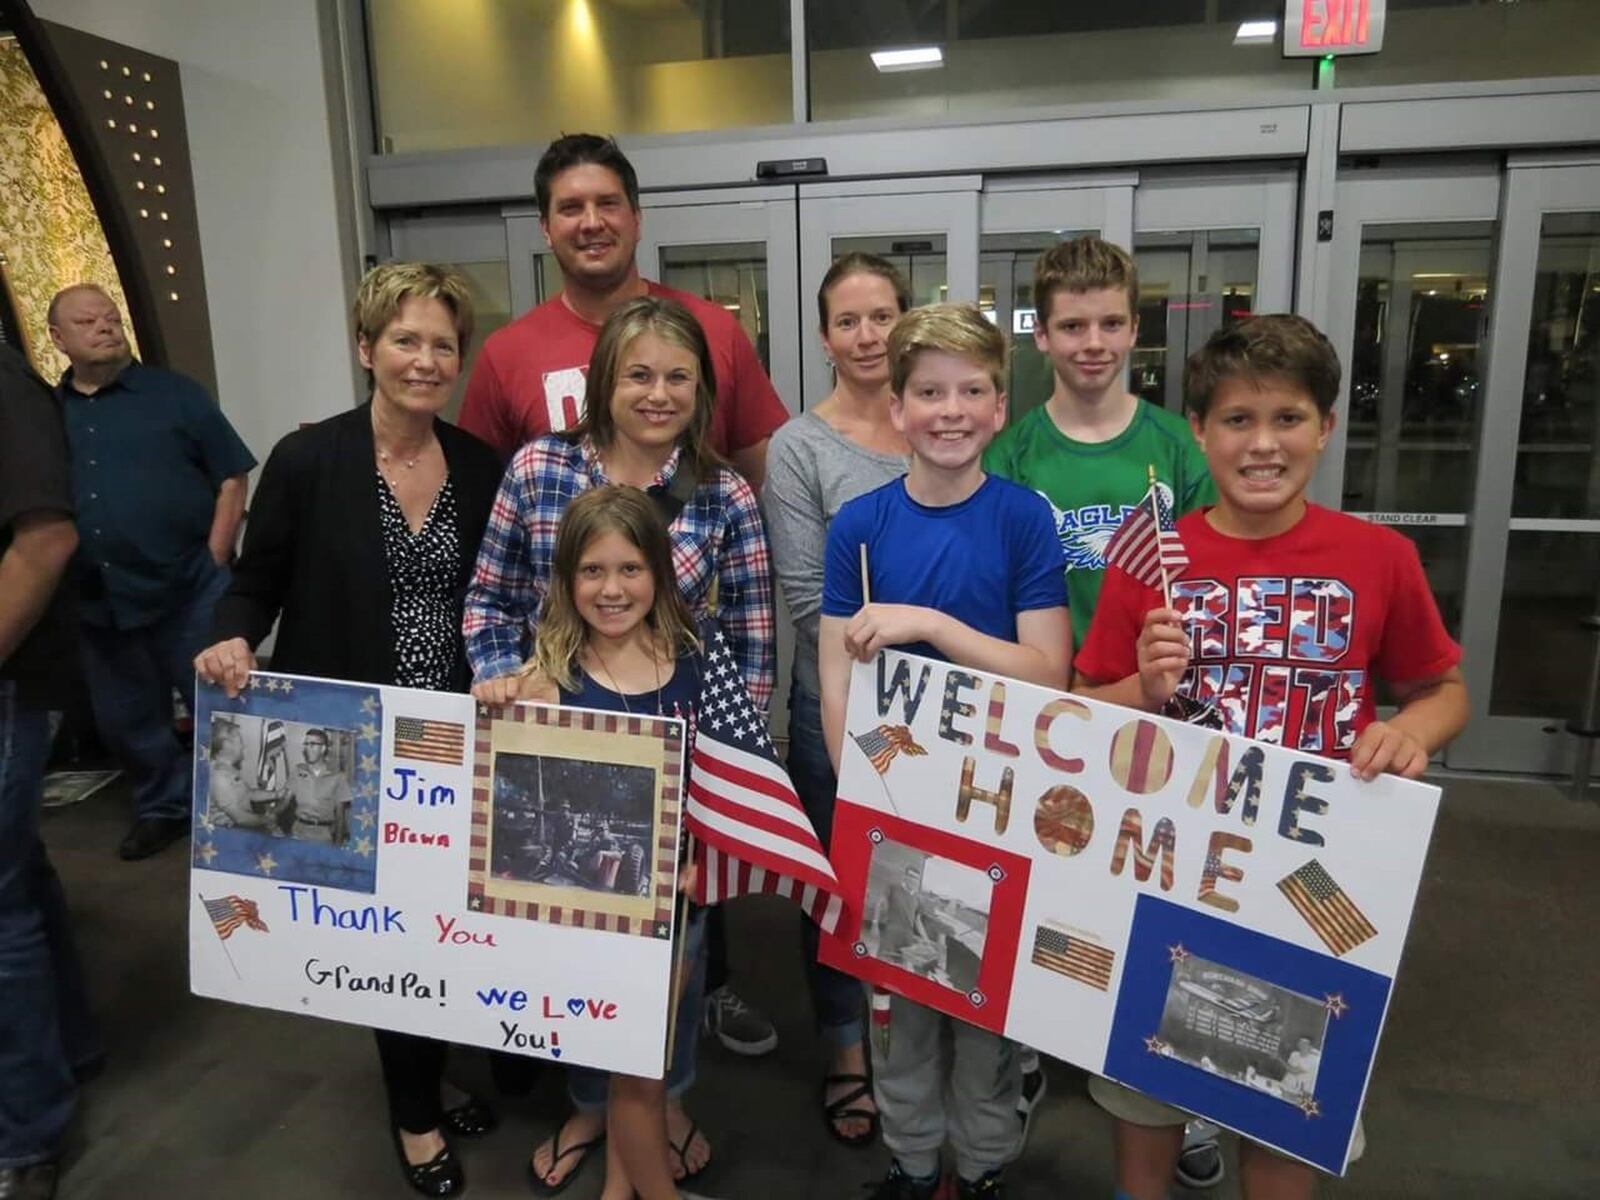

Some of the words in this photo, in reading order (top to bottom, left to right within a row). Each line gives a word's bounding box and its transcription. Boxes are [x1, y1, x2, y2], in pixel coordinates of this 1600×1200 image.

[1302, 0, 1370, 46] EXIT
[1368, 514, 1400, 522] STAND
[1403, 514, 1437, 523] CLEAR
[1170, 576, 1354, 663] RED
[1176, 663, 1366, 752] HITE
[876, 650, 1337, 848] WELCOME
[386, 768, 455, 807] Jim
[384, 822, 450, 848] Brown
[955, 756, 1254, 913] HOME
[278, 885, 406, 934] Thank
[435, 914, 498, 948] You
[500, 1020, 562, 1059] You!
